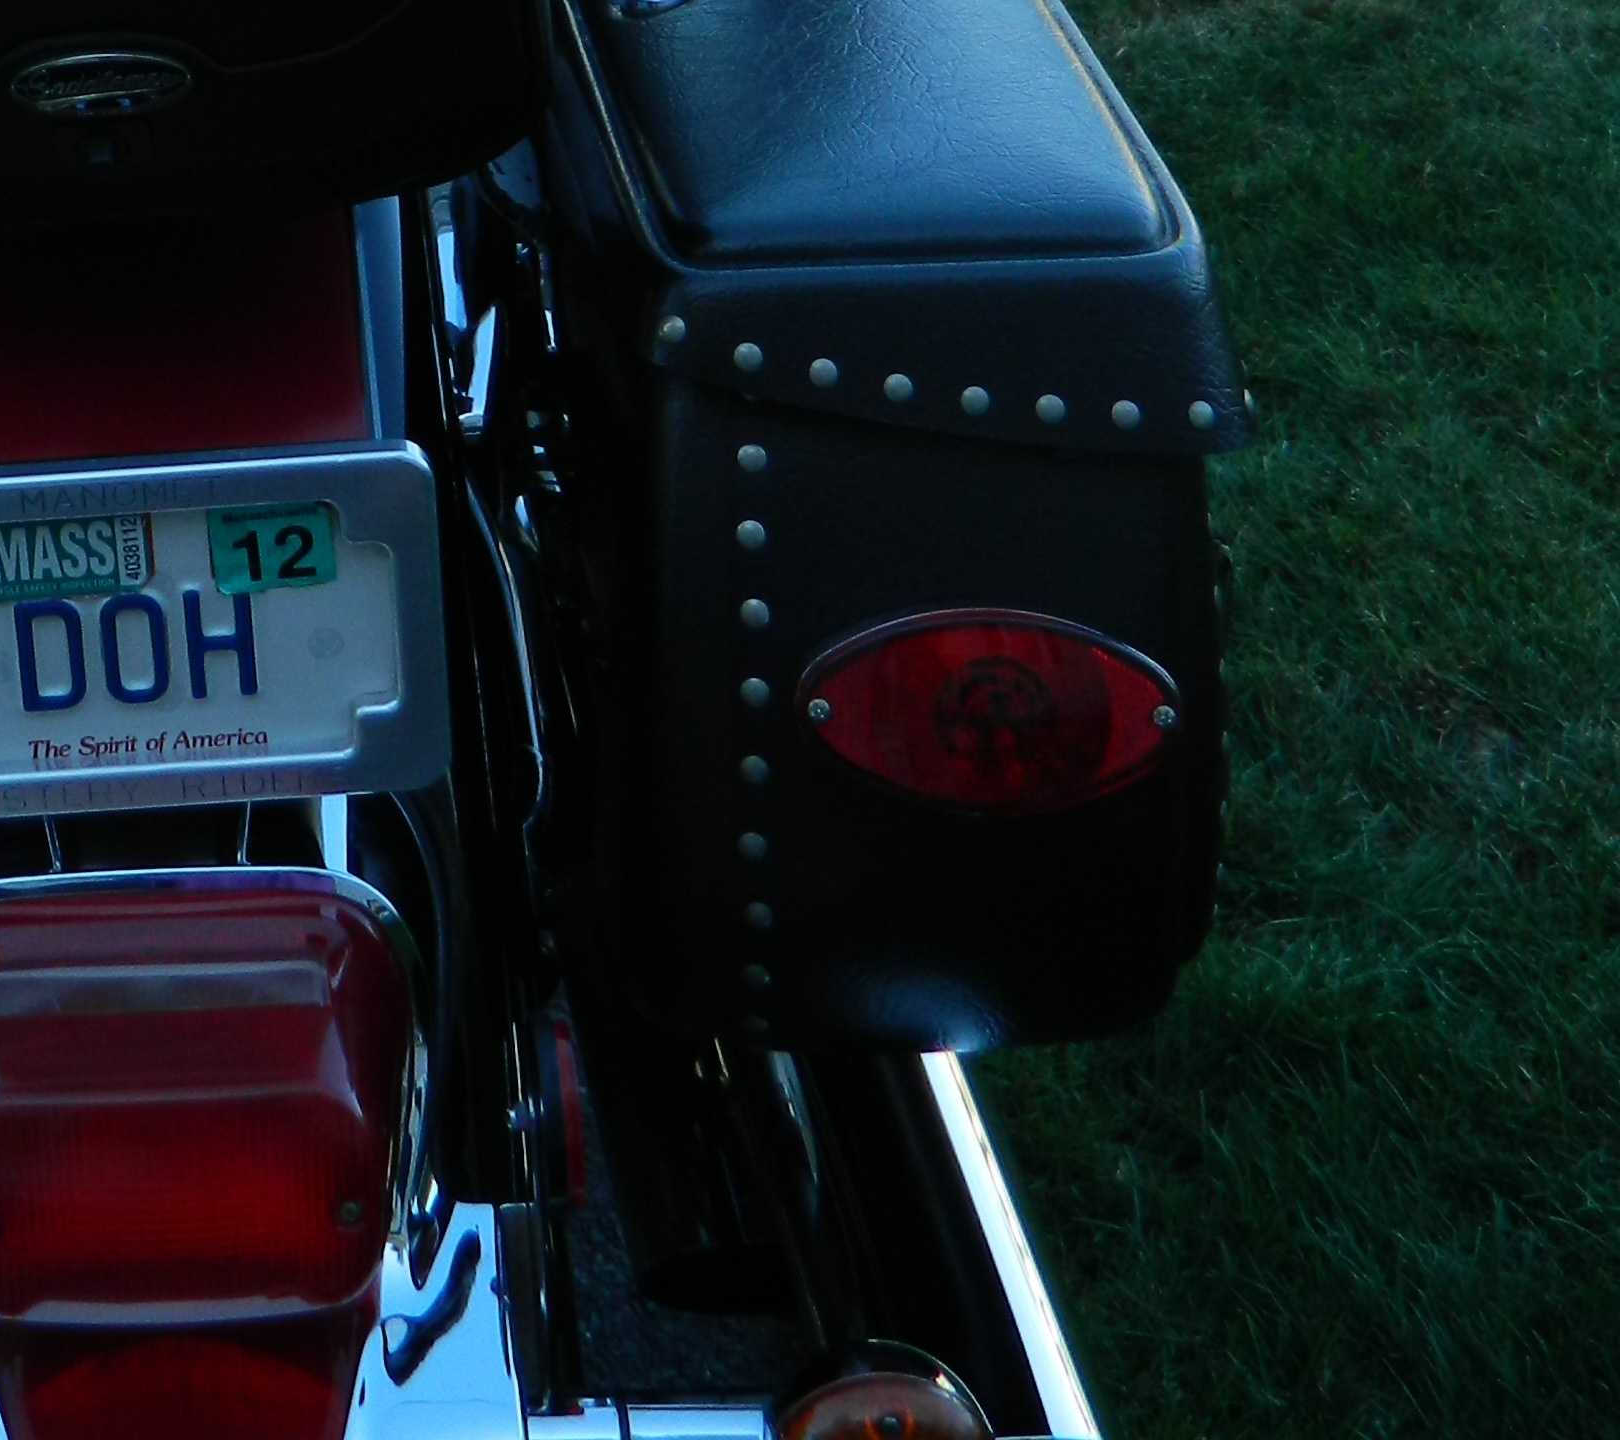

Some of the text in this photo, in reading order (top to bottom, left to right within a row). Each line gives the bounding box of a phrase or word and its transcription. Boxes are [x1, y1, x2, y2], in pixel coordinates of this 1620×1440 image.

[231, 525, 317, 582] 12
[13, 590, 259, 712] DOH
[28, 727, 269, 760] The Spirit of America
